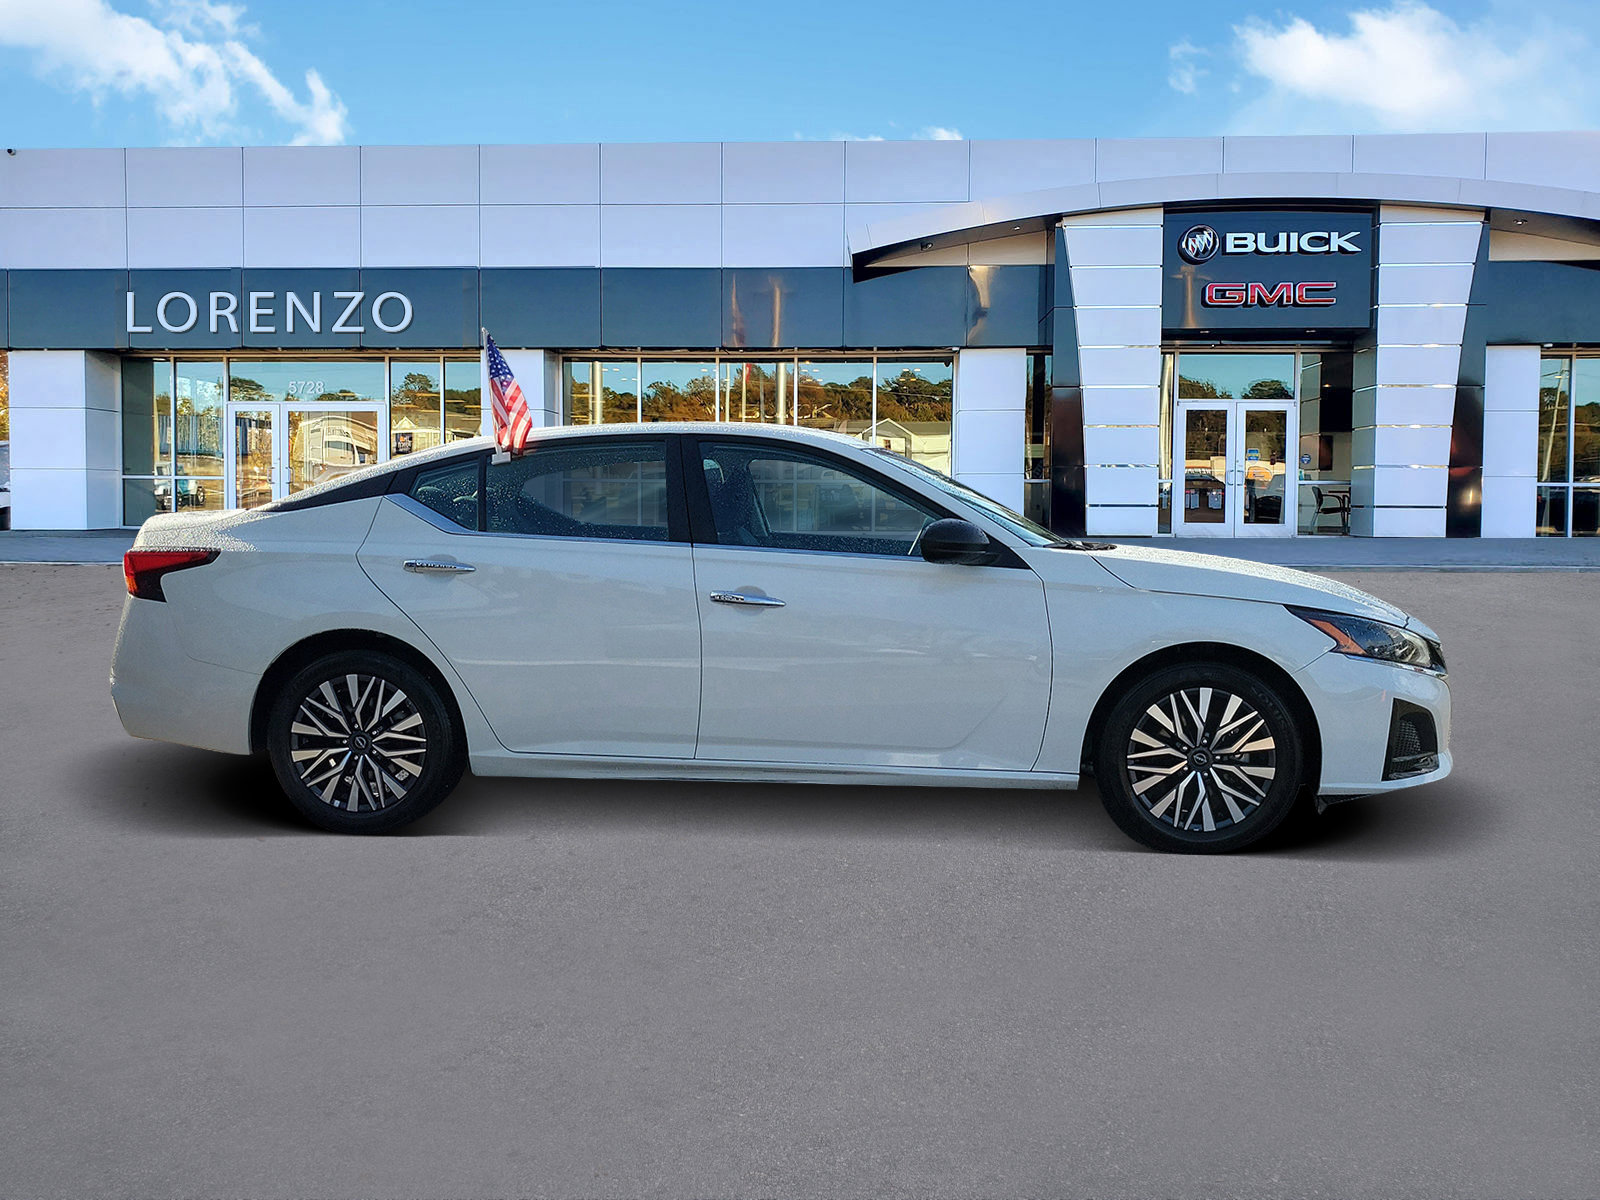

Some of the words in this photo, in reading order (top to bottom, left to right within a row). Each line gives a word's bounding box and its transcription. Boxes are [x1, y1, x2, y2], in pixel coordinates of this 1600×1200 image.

[1225, 231, 1362, 253] BUICK
[1206, 282, 1337, 305] GMC
[126, 291, 413, 333] LORENZO
[288, 381, 325, 394] 5728
